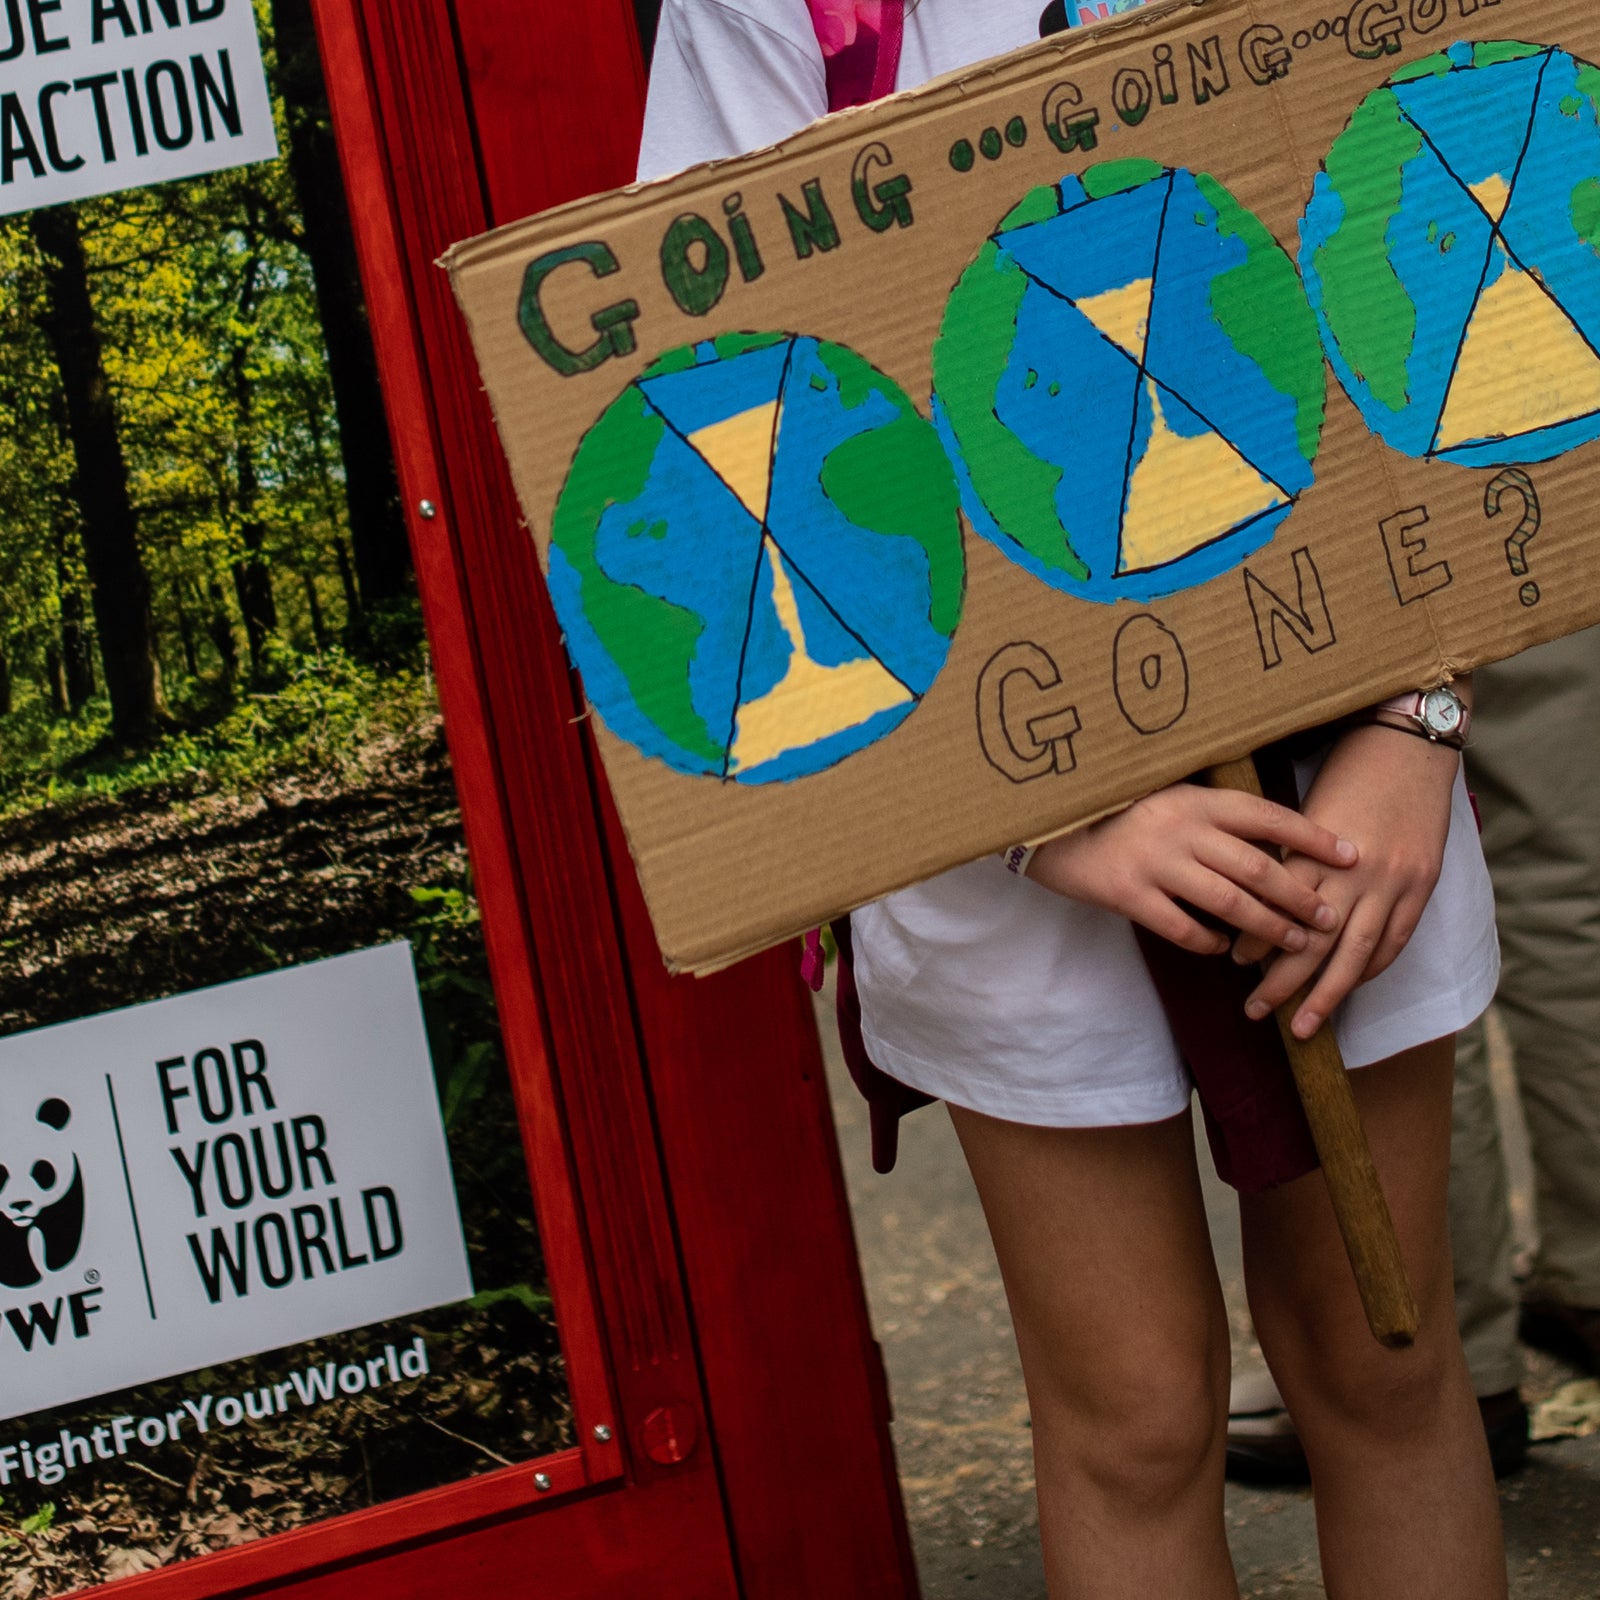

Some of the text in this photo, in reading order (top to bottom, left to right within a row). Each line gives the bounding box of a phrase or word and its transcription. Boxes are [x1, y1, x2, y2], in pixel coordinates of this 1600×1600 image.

[1, 49, 244, 184] ACTION
[156, 1038, 276, 1135] FOR
[170, 1114, 337, 1218] YOUR
[186, 1186, 404, 1304] WORLD
